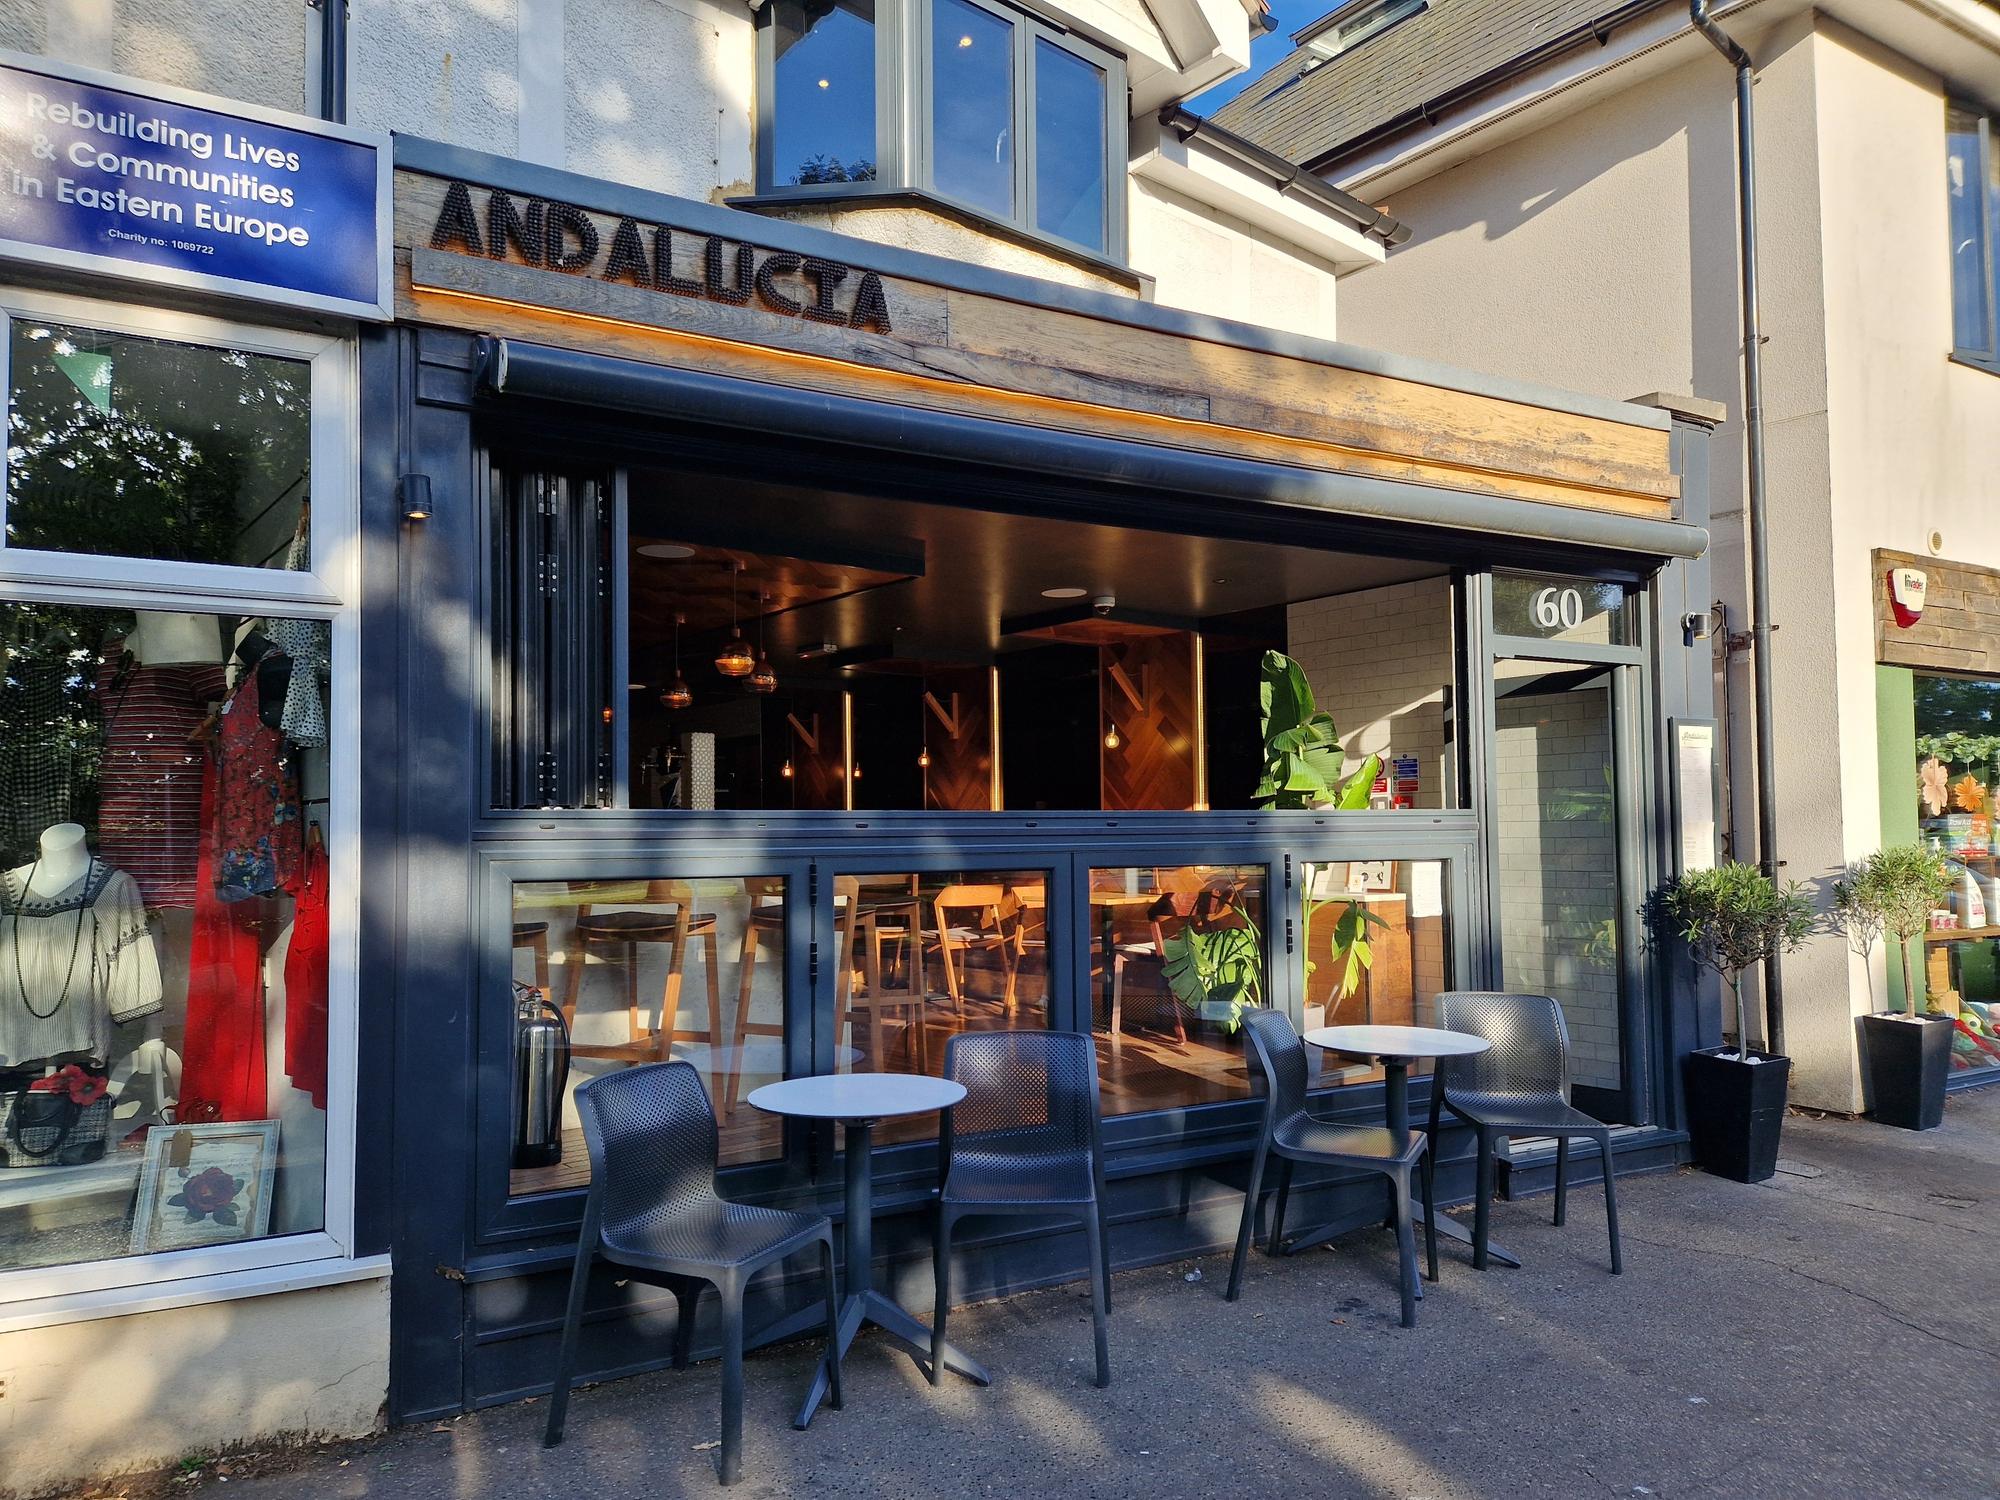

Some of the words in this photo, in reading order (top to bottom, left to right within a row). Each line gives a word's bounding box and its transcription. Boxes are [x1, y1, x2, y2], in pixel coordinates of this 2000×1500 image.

[26, 92, 213, 160] Rebuilding
[224, 133, 300, 172] Lives
[12, 169, 43, 198] in
[57, 177, 183, 224] Eastern
[195, 203, 310, 247] Europe
[31, 133, 57, 162] &
[68, 141, 294, 208] Communities
[108, 228, 148, 245] Charity
[150, 237, 168, 247] no:
[171, 240, 214, 255] 1069722
[429, 180, 892, 336] ANDALUCIA
[1536, 587, 1584, 630] 60
